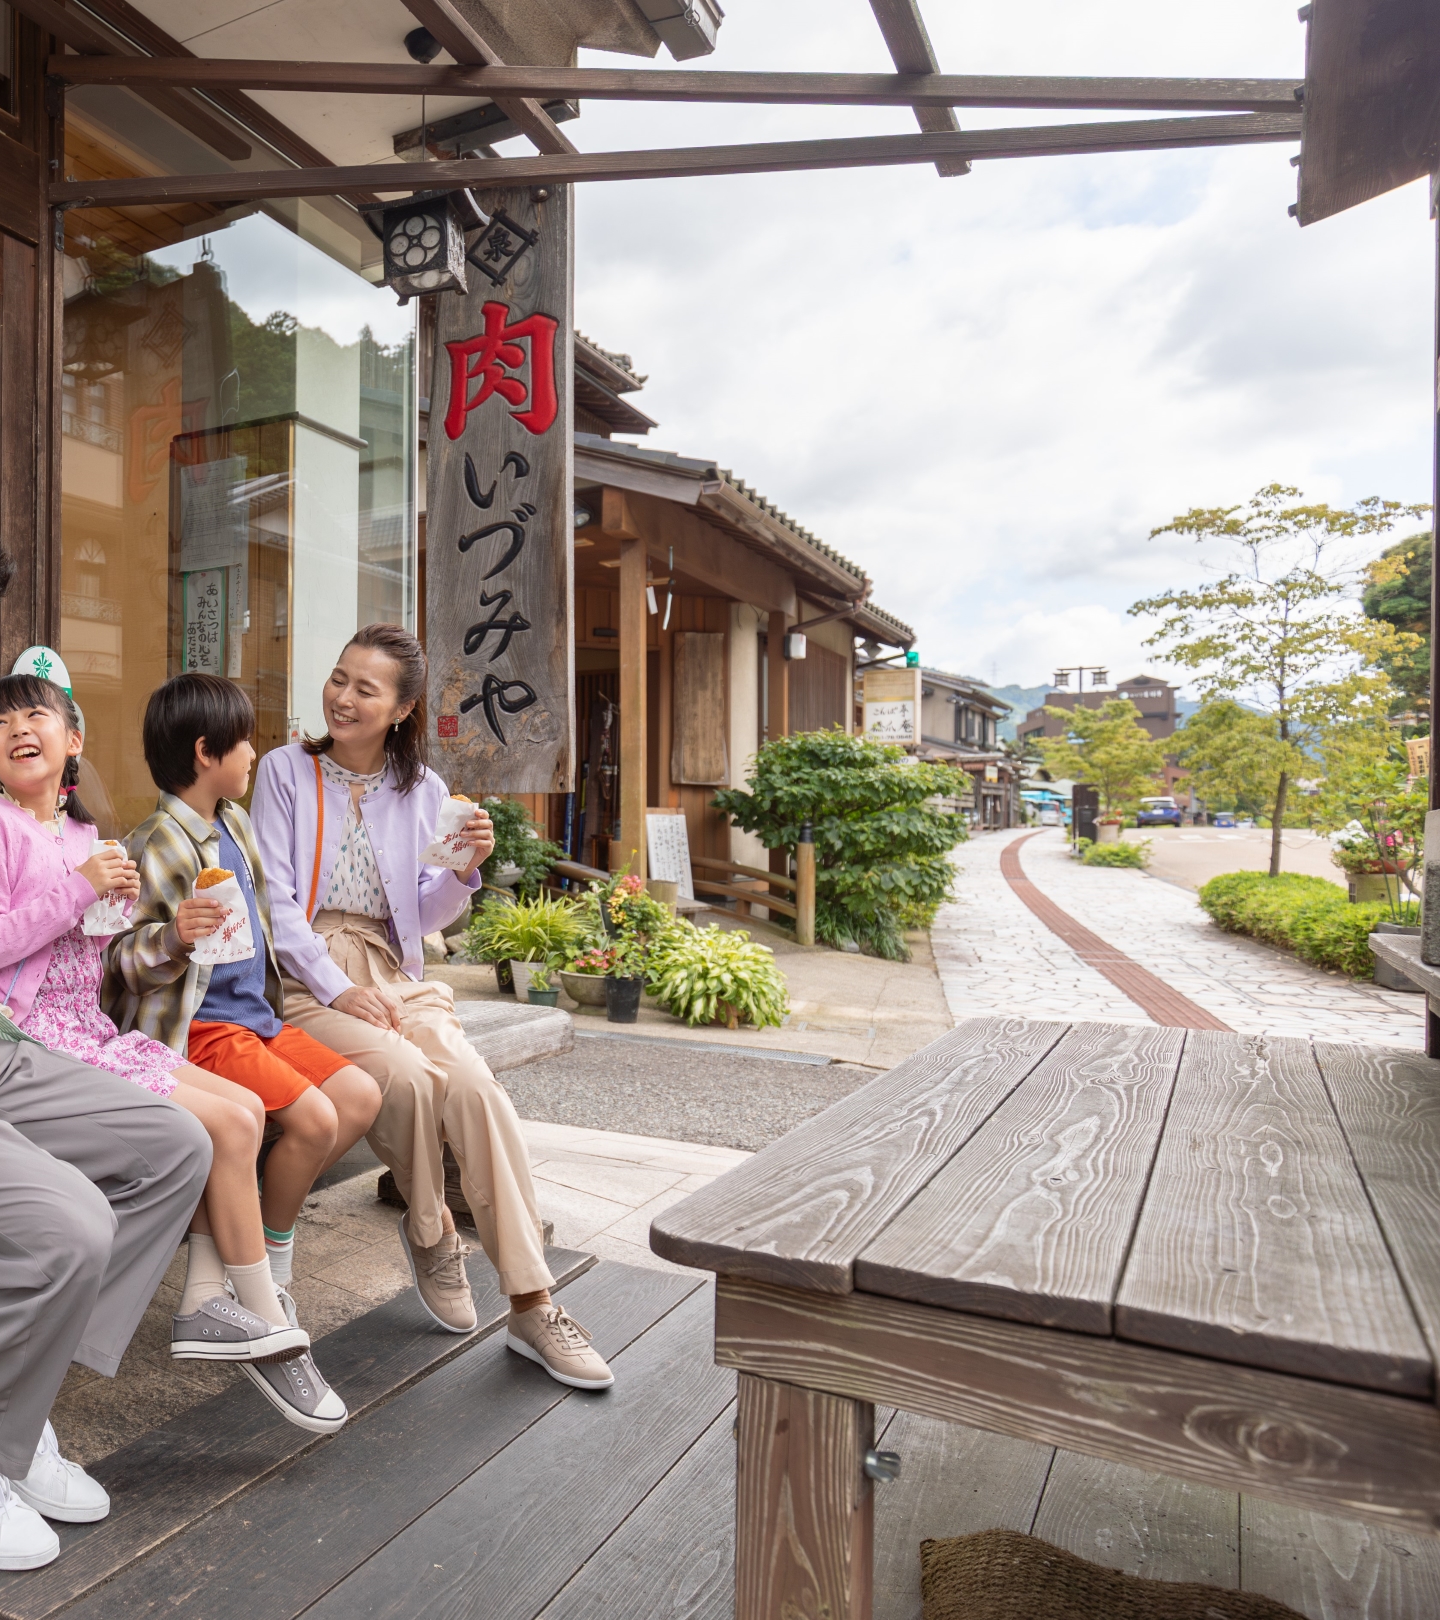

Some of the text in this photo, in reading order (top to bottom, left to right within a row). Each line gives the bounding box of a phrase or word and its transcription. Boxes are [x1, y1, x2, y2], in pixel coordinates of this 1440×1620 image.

[444, 300, 559, 746] 肉 いづみや
[196, 596, 211, 667] みんなの心を
[206, 582, 219, 644] あいさつは
[187, 621, 198, 673] あたため
